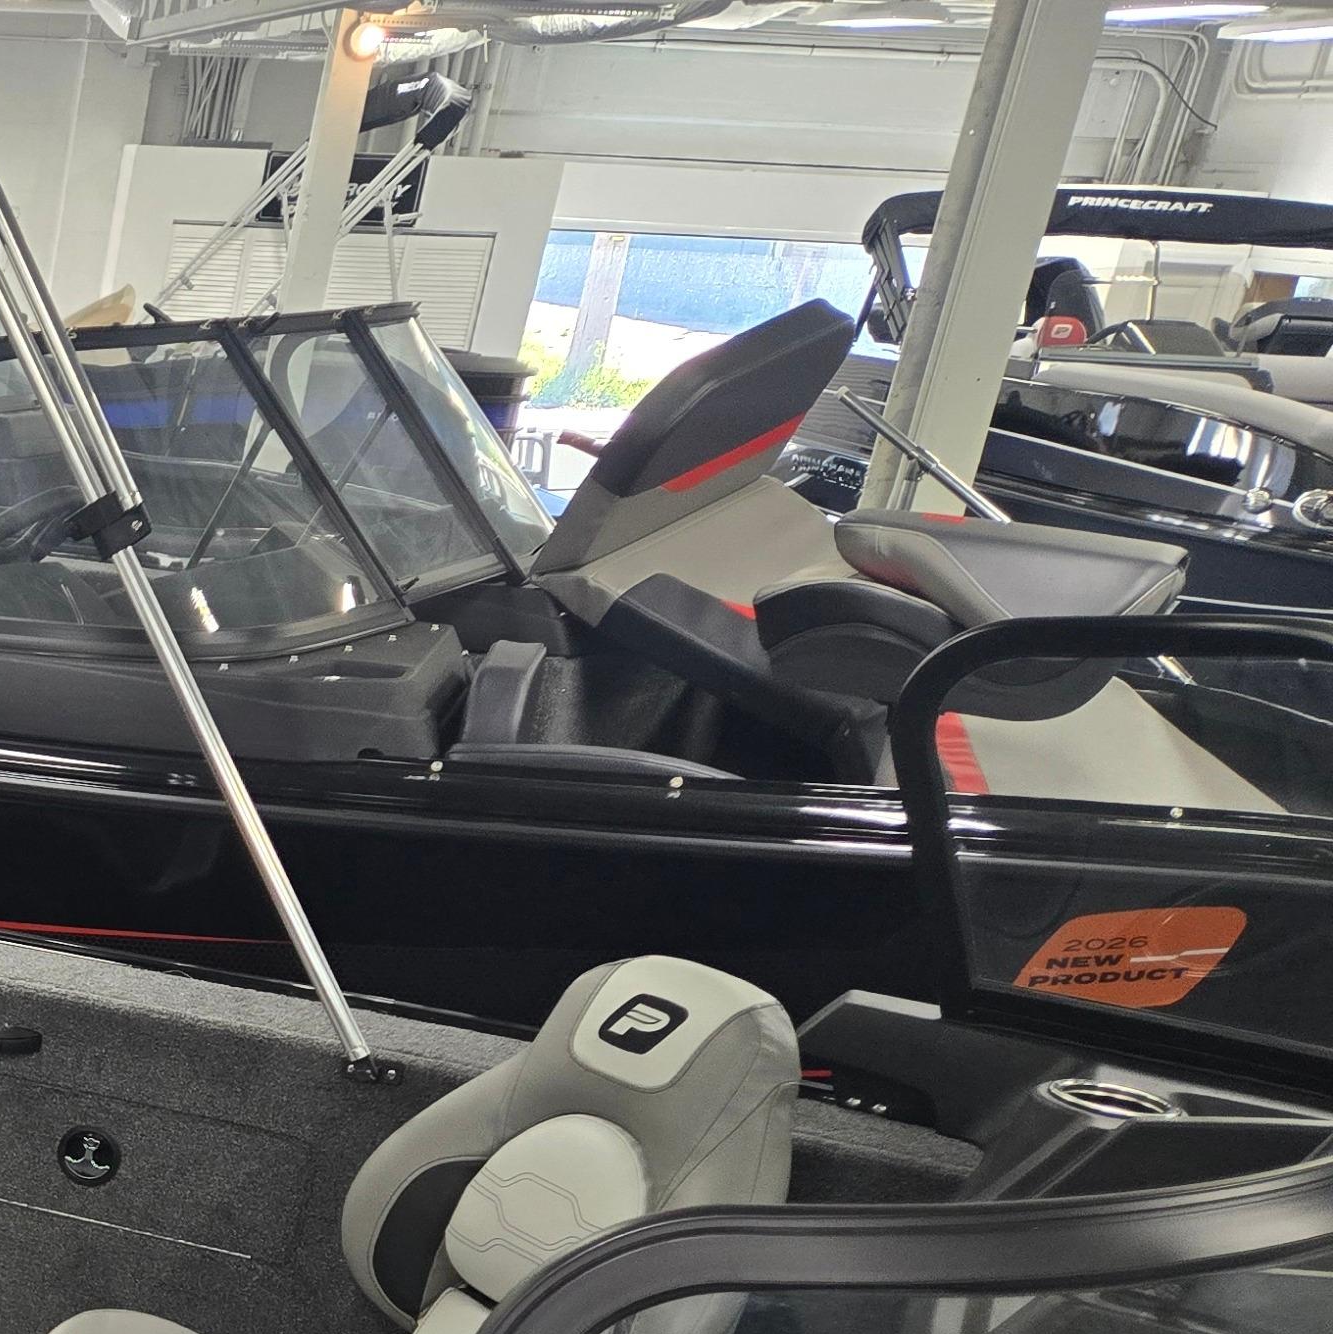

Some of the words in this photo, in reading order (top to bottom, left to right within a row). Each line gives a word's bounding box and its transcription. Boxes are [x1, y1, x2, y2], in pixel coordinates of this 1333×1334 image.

[1067, 195, 1214, 213] PRINCECRAFT
[1061, 936, 1149, 952] 2026
[1045, 954, 1125, 970] NEW
[1027, 966, 1191, 988] PRODUCT
